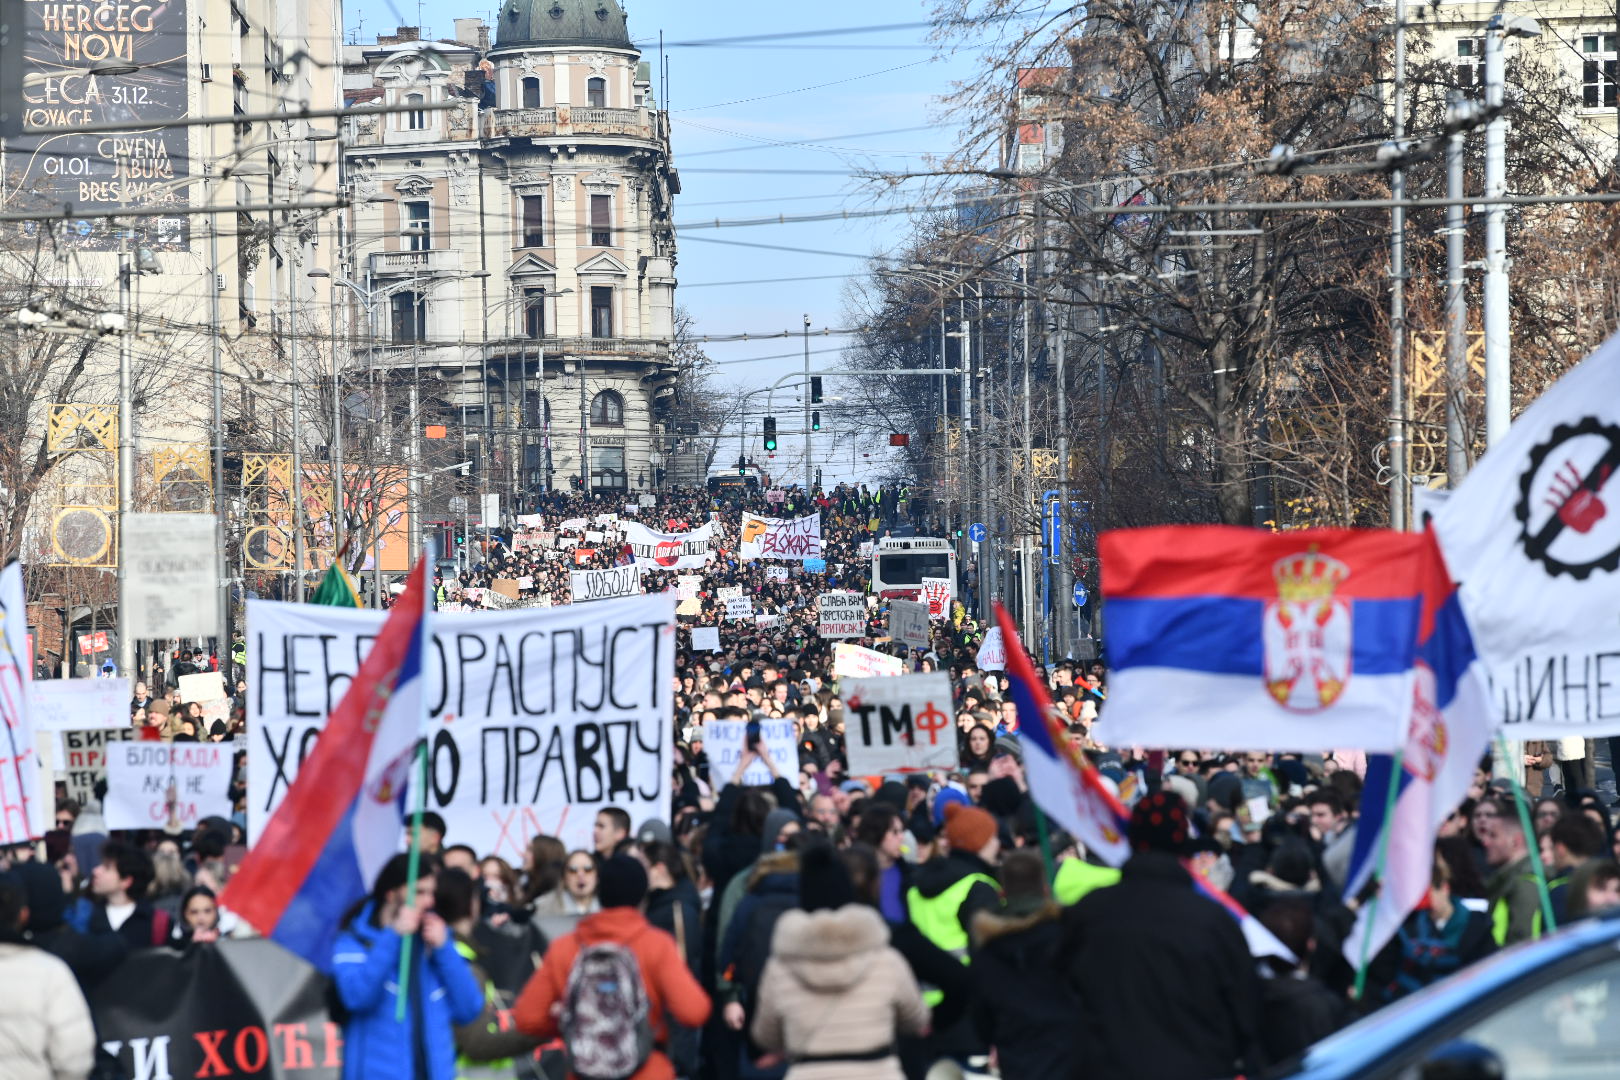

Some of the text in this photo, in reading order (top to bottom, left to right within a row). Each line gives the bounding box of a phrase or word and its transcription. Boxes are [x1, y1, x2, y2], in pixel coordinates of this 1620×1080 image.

[43, 4, 154, 32] HERCEG
[64, 32, 133, 61] NOVI
[111, 86, 152, 105] 31.12.
[98, 138, 168, 158] CRVENA
[43, 157, 93, 175] 01.01.
[112, 158, 174, 179] JABUKA
[762, 533, 819, 556] BLOKADE
[821, 595, 864, 606] СЛАБА ВАМ
[854, 701, 948, 746] ТМФ
[127, 746, 220, 768] БЛОКАДА
[481, 720, 662, 805] ПРАВДУ
[186, 774, 205, 794] НЕ
[103, 1035, 171, 1080] И
